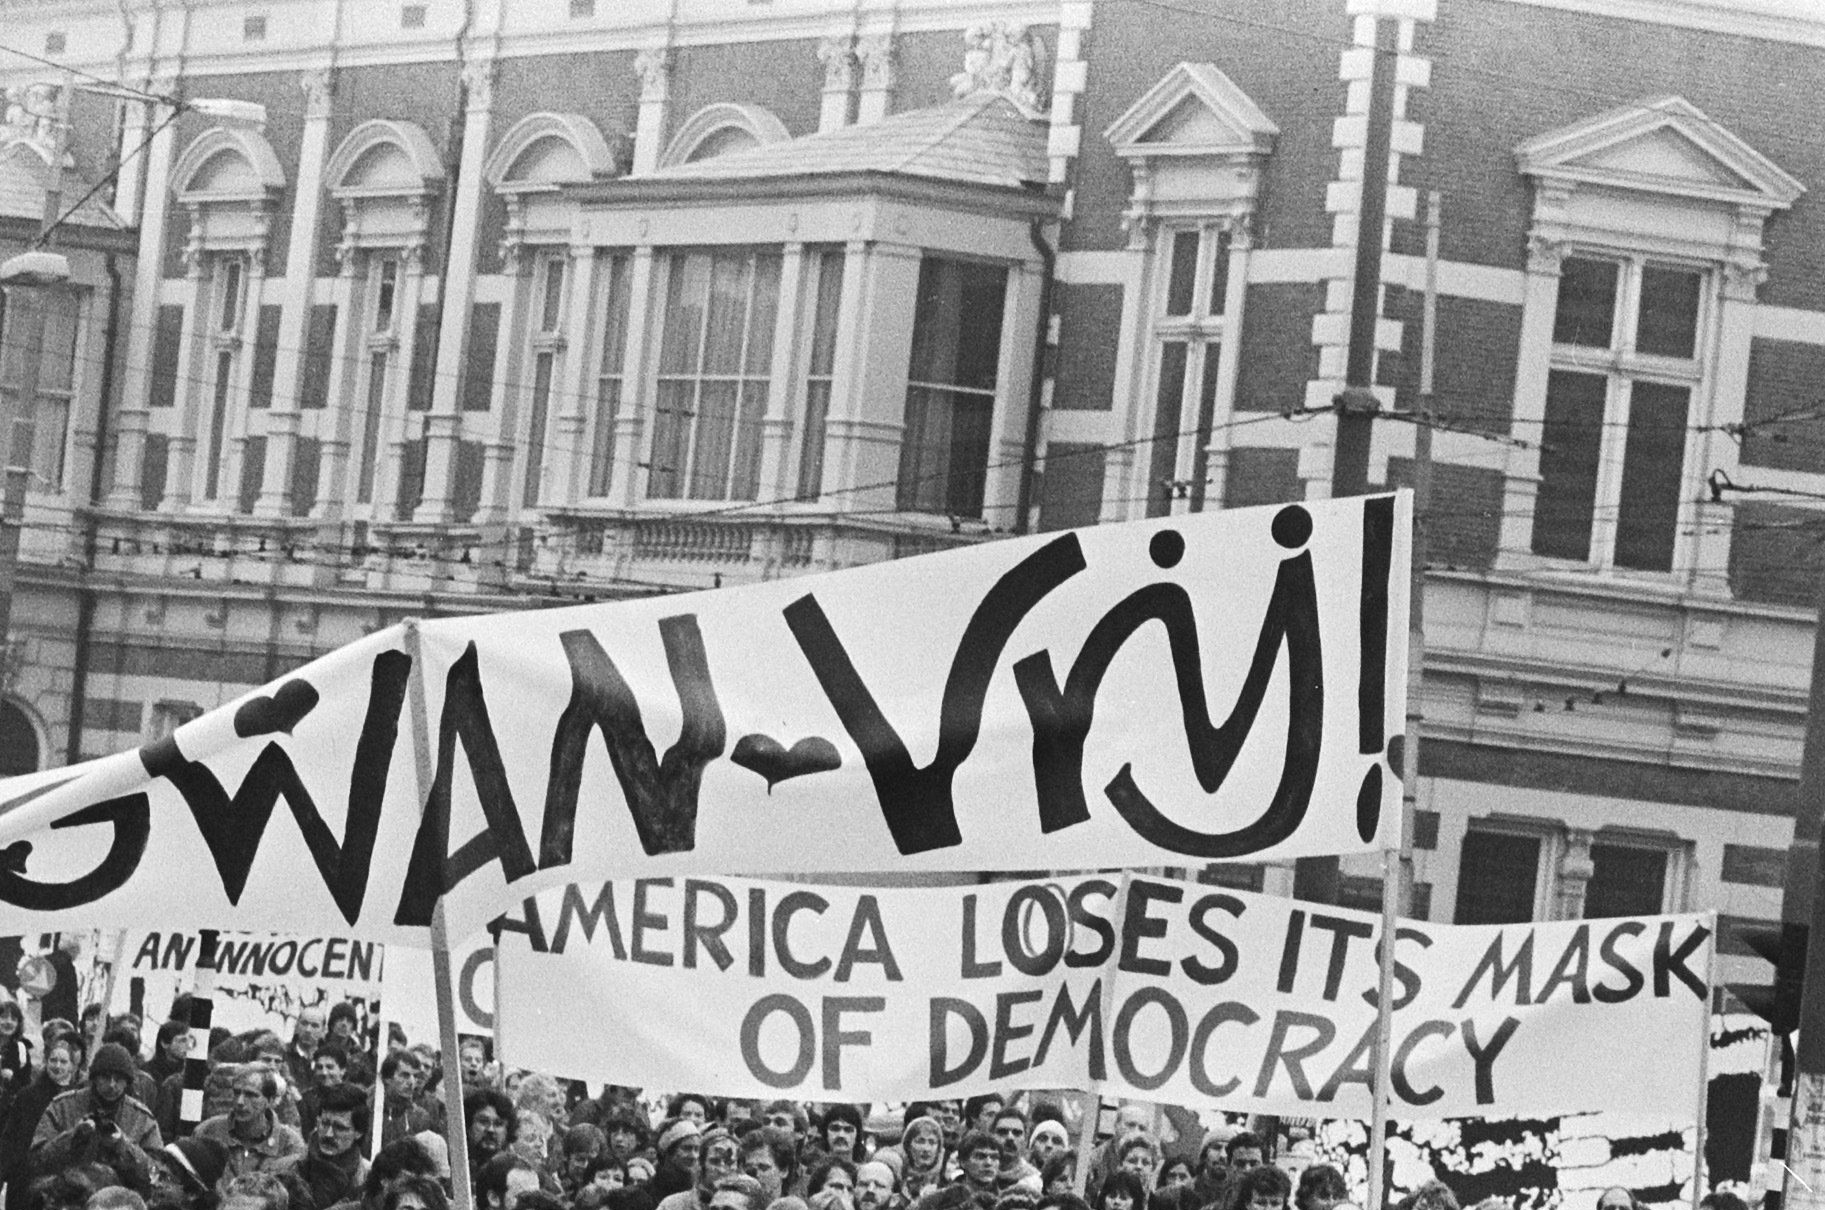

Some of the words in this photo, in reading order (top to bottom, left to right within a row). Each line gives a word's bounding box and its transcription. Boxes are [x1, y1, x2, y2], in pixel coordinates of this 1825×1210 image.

[132, 931, 196, 971] AN
[486, 877, 903, 984] AMERICA
[961, 879, 1247, 986] LOSES
[1276, 909, 1434, 1012] ITS
[1451, 921, 1710, 1009] MASK
[739, 993, 886, 1092] OF
[929, 978, 1521, 1106] DEMOCRACY
